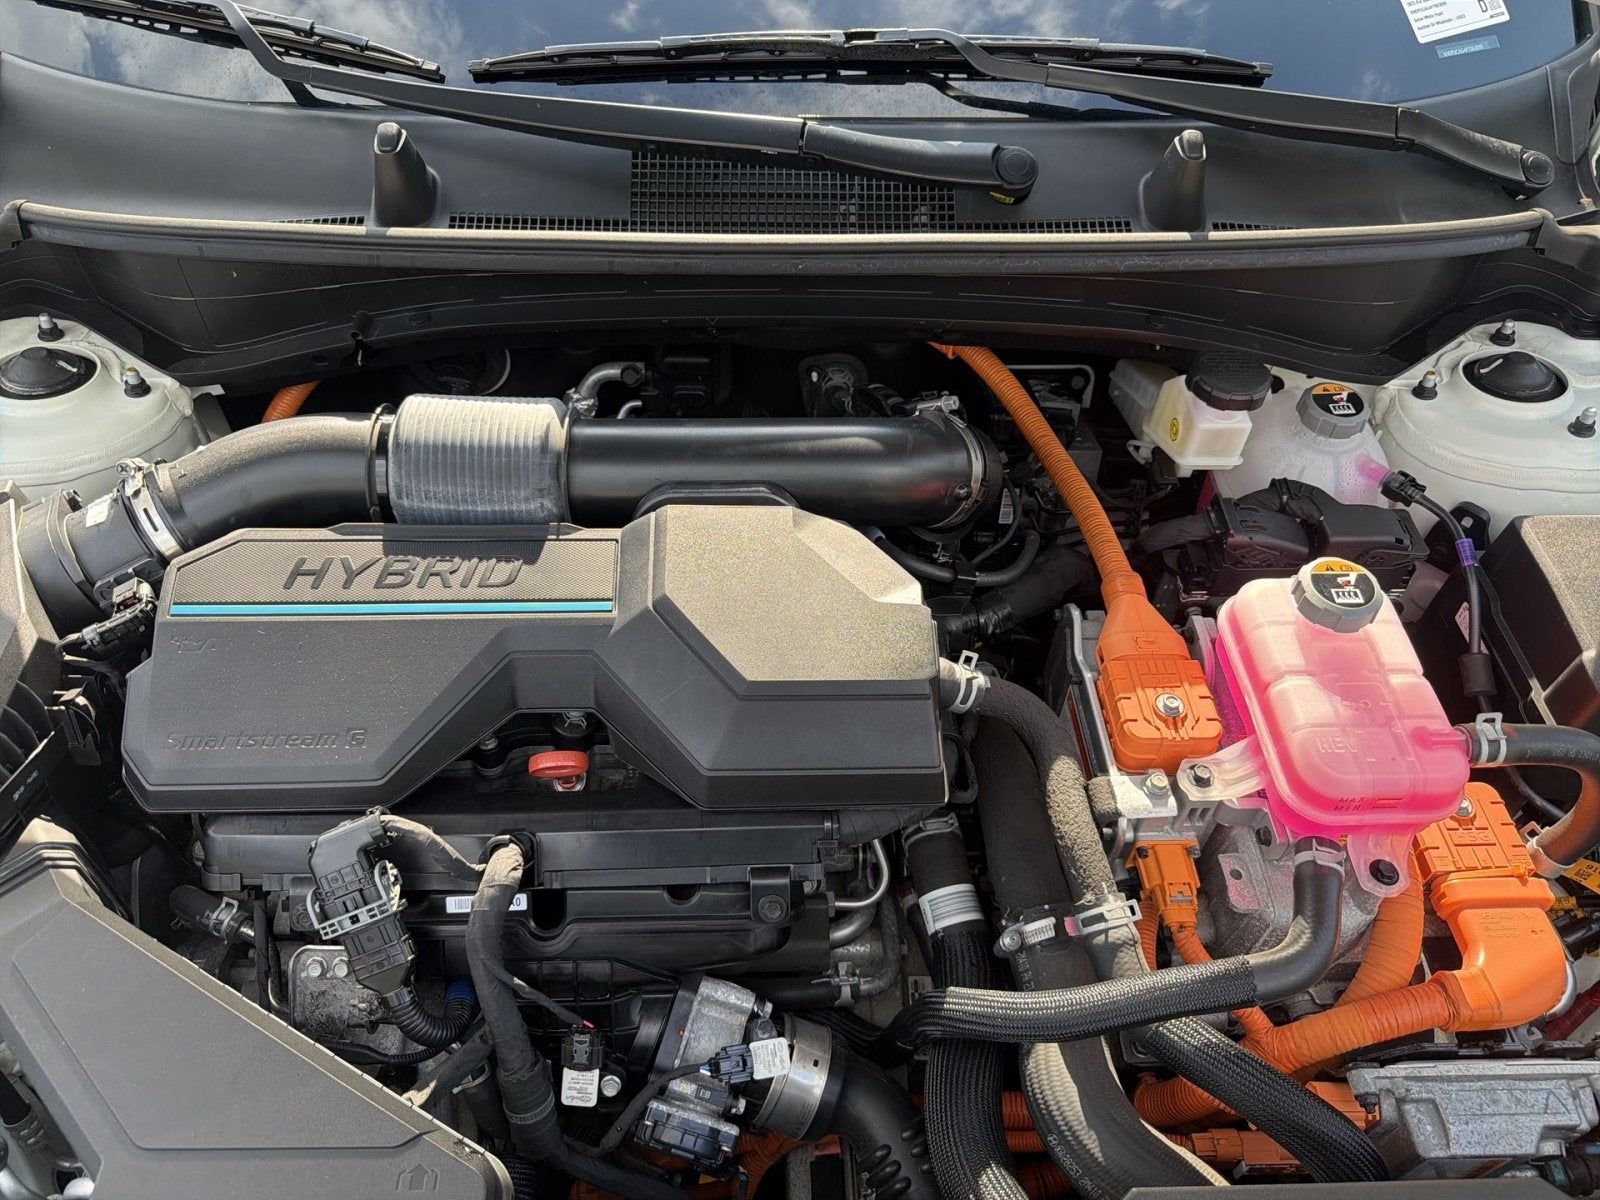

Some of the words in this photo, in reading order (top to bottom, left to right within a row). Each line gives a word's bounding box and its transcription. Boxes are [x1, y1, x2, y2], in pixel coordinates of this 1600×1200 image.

[283, 556, 524, 590] HYBRID
[167, 731, 339, 751] Smartstream
[345, 726, 370, 750] G
[1315, 735, 1361, 753] HEV
[1333, 804, 1362, 812] MIN
[1338, 796, 1367, 804] MAX
[1454, 830, 1493, 842] HSG
[1060, 1154, 1082, 1179] 28253
